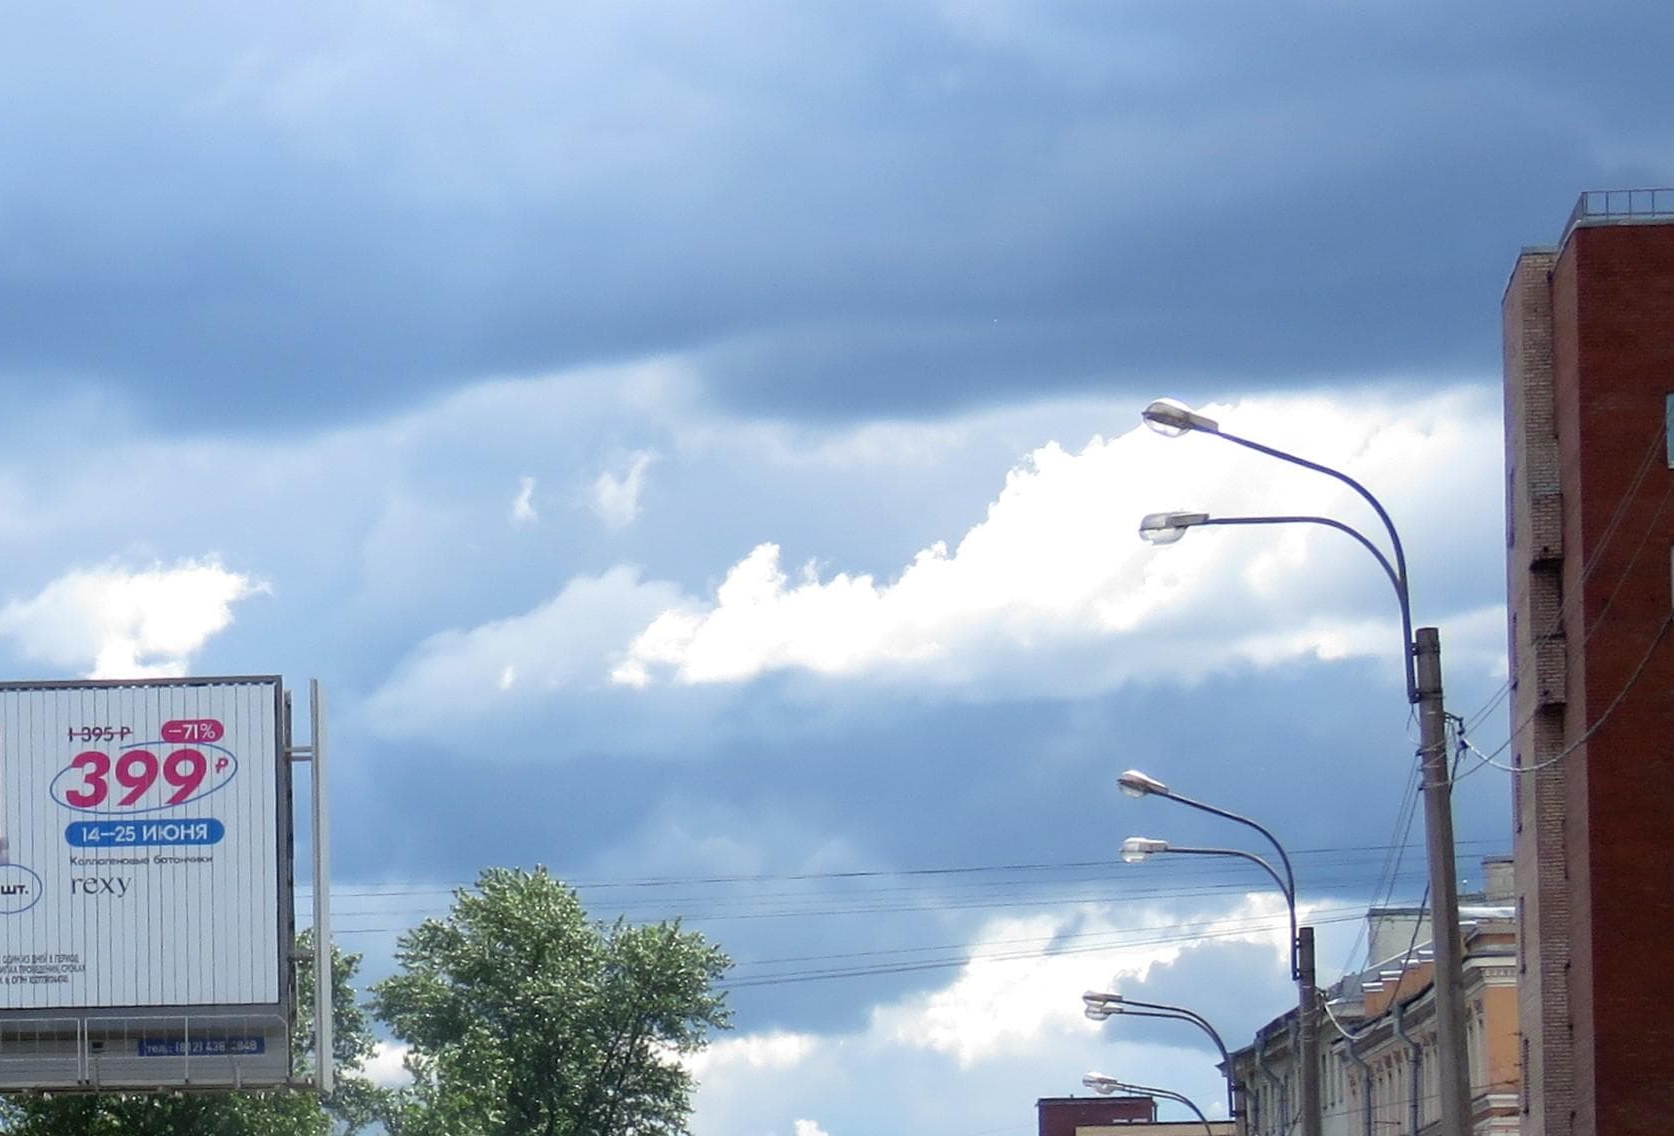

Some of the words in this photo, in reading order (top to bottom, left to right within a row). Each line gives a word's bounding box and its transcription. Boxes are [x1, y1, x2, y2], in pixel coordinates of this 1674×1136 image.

[80, 726, 114, 742] 395
[168, 723, 216, 741] -71%
[65, 748, 207, 808] 399
[81, 825, 136, 843] 14-25
[142, 823, 207, 842] ИЮНЯ
[69, 856, 150, 867] Коллагеновые
[153, 854, 214, 865] батончики
[0, 883, 30, 896] шт.
[71, 876, 132, 898] rexy
